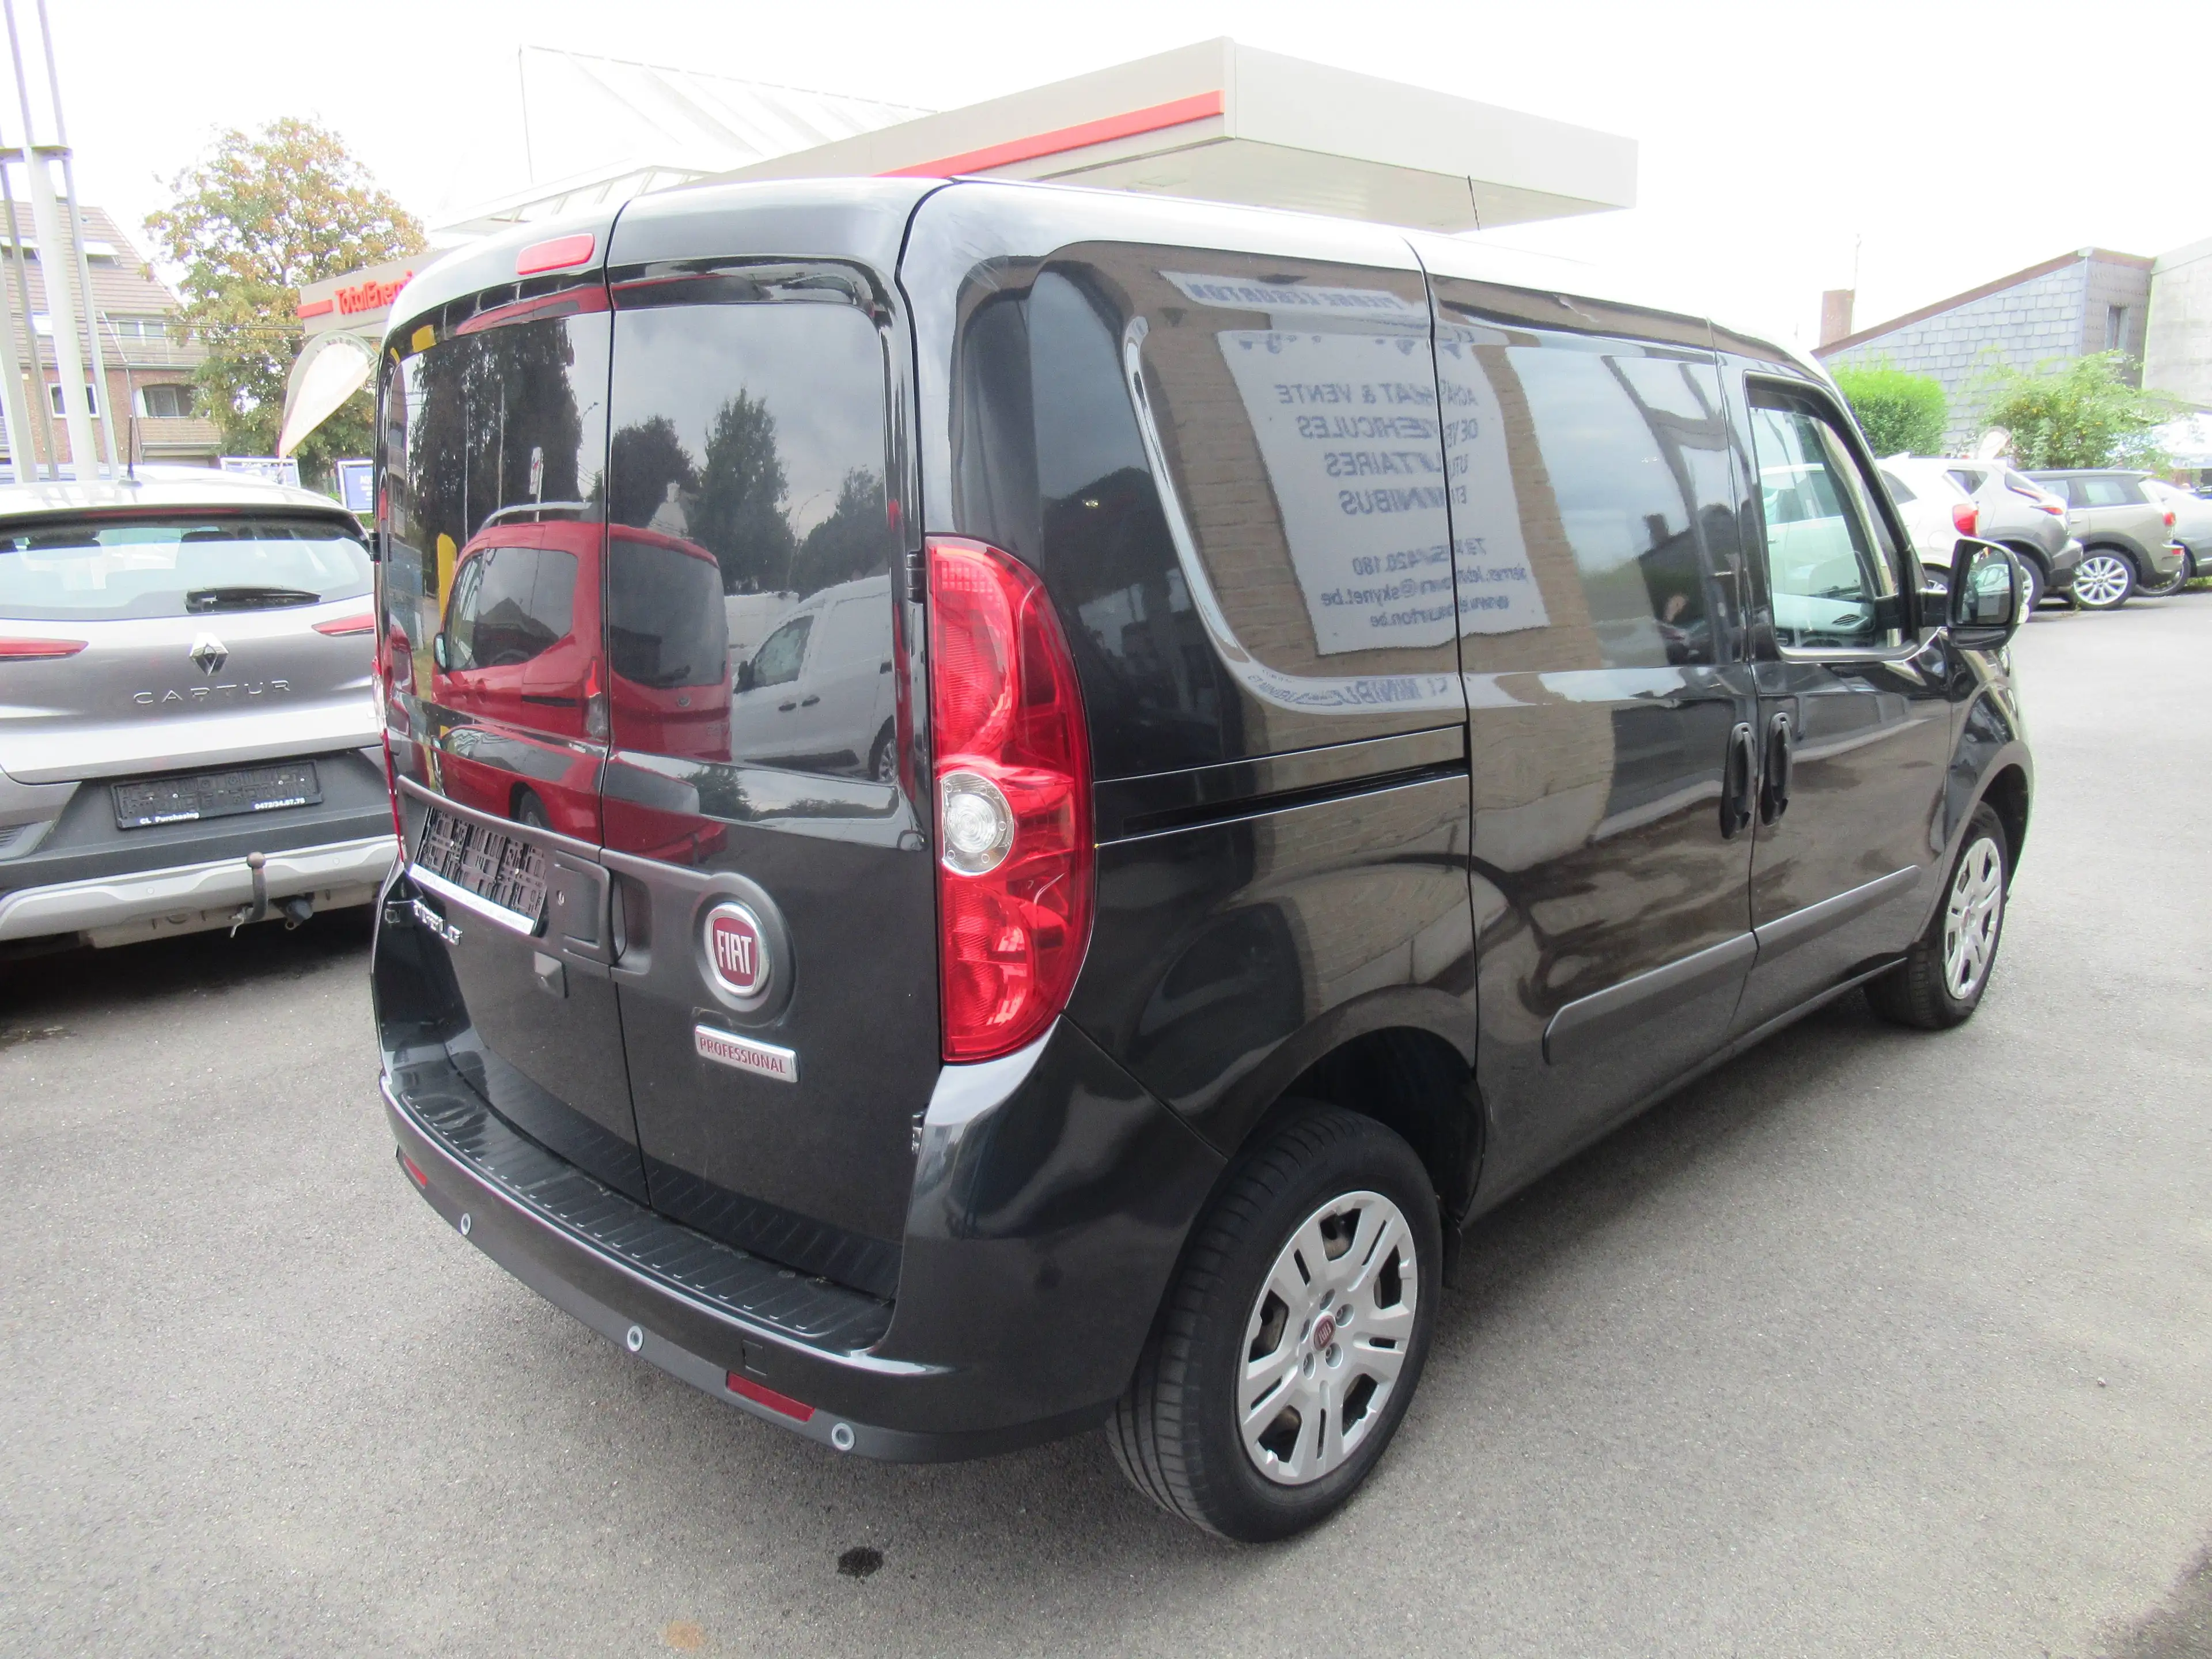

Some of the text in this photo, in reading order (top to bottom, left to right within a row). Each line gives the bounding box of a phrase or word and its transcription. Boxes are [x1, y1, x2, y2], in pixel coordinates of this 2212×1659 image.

[133, 680, 291, 704] CAPTUR
[716, 929, 752, 975] FIAT
[699, 1037, 786, 1075] PROFESSIONAL
